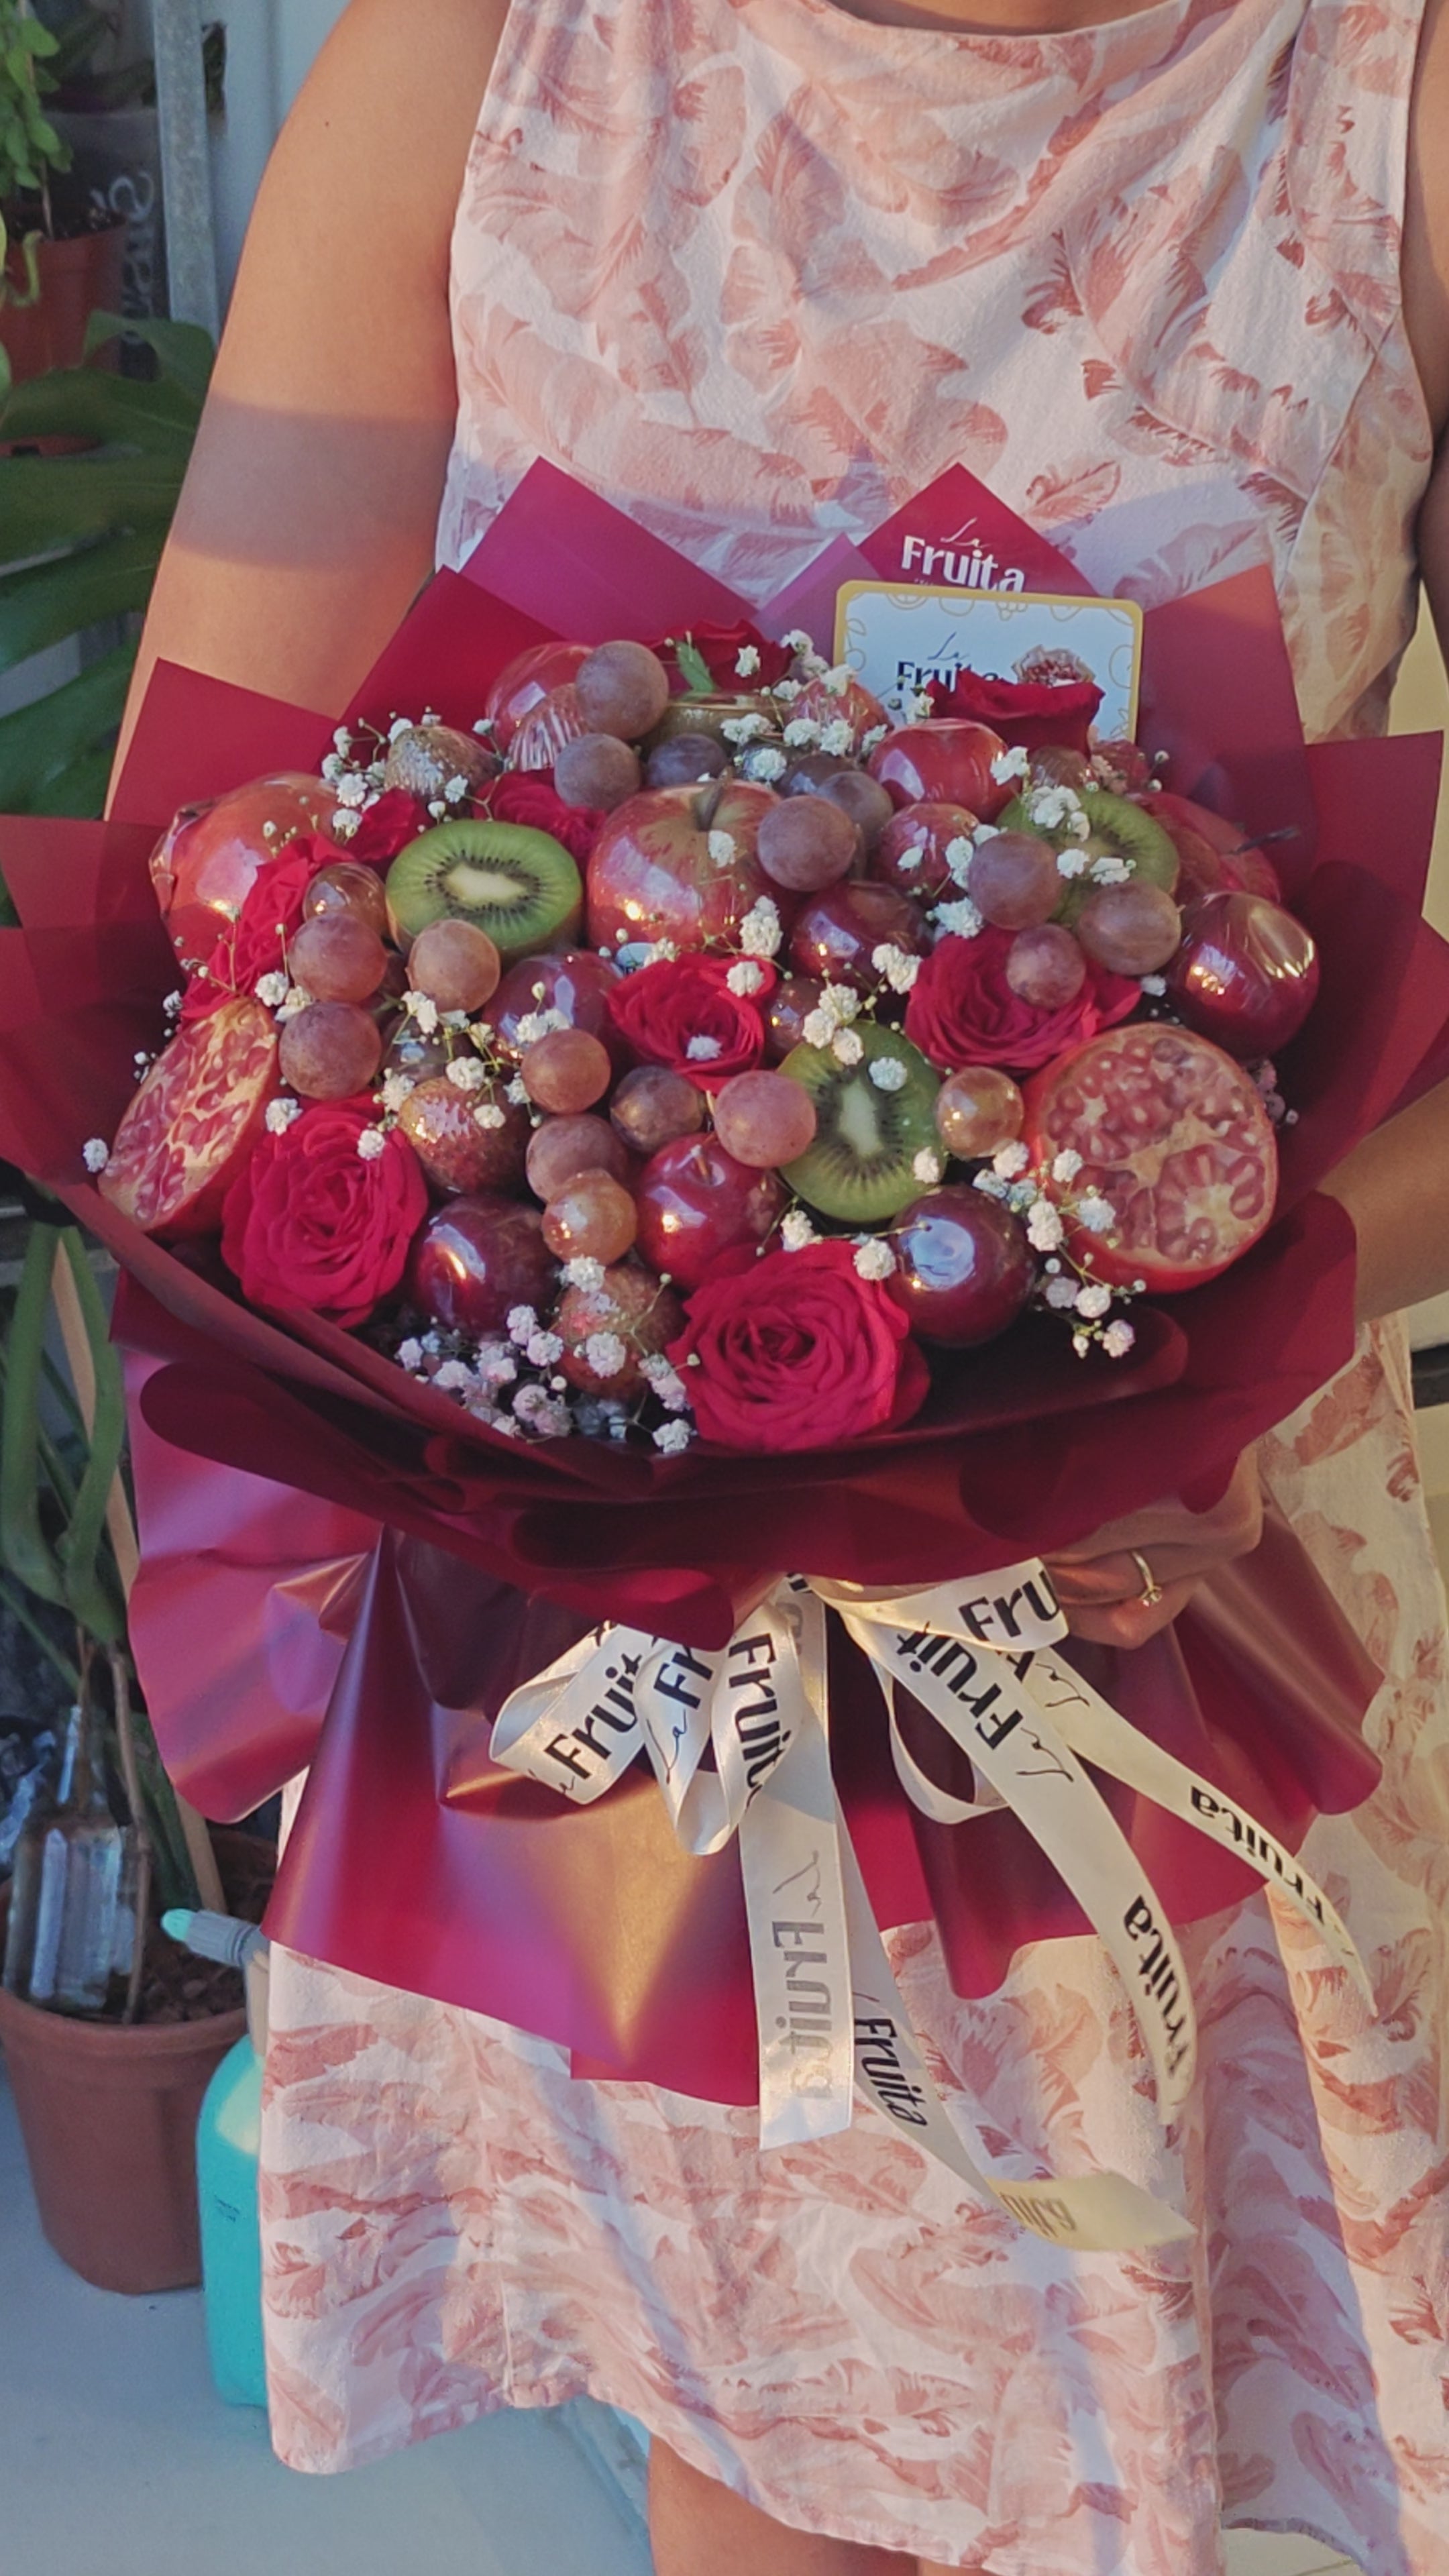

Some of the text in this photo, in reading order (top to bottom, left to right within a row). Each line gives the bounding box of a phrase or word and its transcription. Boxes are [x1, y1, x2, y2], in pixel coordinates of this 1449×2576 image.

[901, 535, 1025, 594] Fruita
[544, 1637, 658, 1780] Fruit
[728, 1632, 792, 1813] Fruit
[1190, 1785, 1325, 1927] Fruita
[854, 2018, 928, 2127] Fruita
